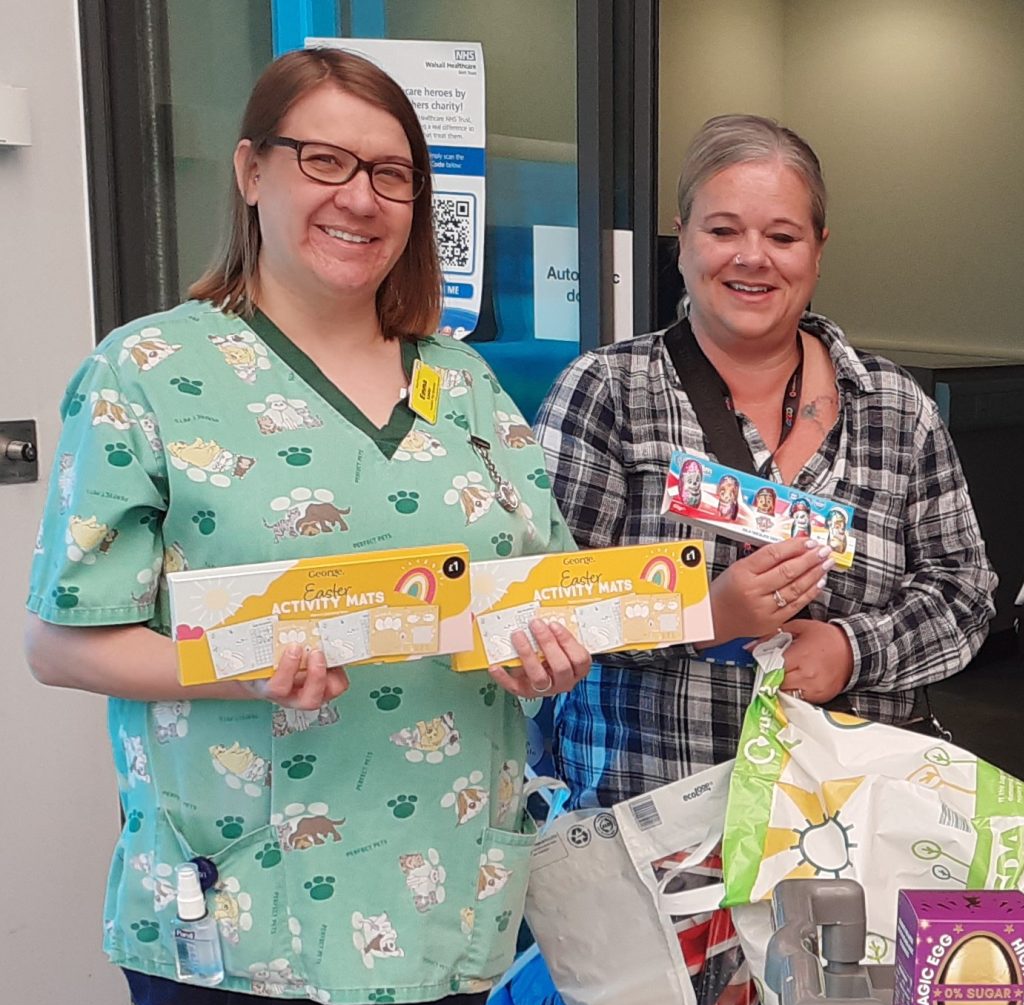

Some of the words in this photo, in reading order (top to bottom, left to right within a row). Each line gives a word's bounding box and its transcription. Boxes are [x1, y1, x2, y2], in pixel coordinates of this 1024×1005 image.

[455, 50, 476, 60] NHS
[446, 62, 477, 70] Healthcare
[424, 87, 453, 98] heroes
[455, 88, 466, 99] by
[431, 101, 464, 113] charity!
[447, 285, 460, 295] ME
[353, 537, 377, 549] PERFECT
[378, 533, 393, 543] PETS
[562, 555, 596, 566] George.
[308, 568, 346, 579] George.
[560, 569, 602, 588] Easter
[303, 583, 352, 602] Easter
[533, 582, 594, 602] ACTIVITY
[598, 578, 633, 594] MATS
[271, 596, 341, 616] ACTIVITY
[346, 591, 385, 607] MATS
[926, 933, 954, 967] EGG
[944, 988, 964, 999] 0%
[966, 988, 1012, 1000] SUGAR
